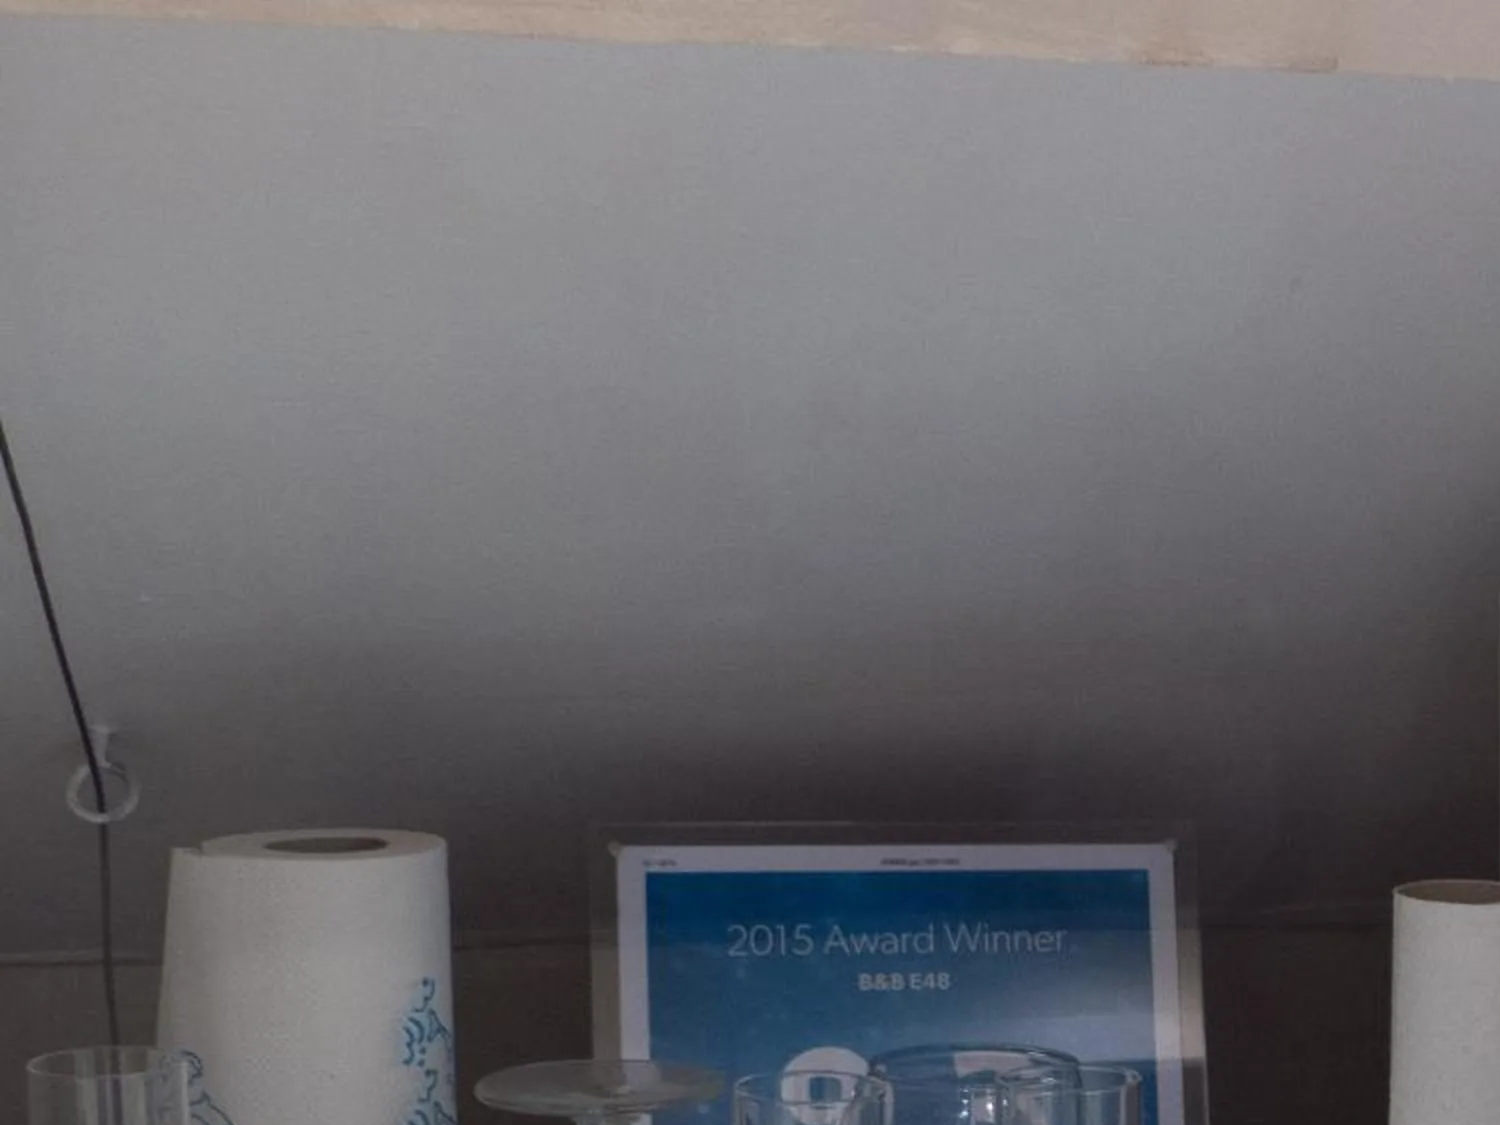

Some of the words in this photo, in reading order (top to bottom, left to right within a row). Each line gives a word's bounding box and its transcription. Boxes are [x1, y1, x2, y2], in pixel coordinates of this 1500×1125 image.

[726, 923, 814, 958] 2015
[823, 922, 935, 956] Award
[943, 920, 1069, 953] Winner
[858, 972, 905, 992] B&B
